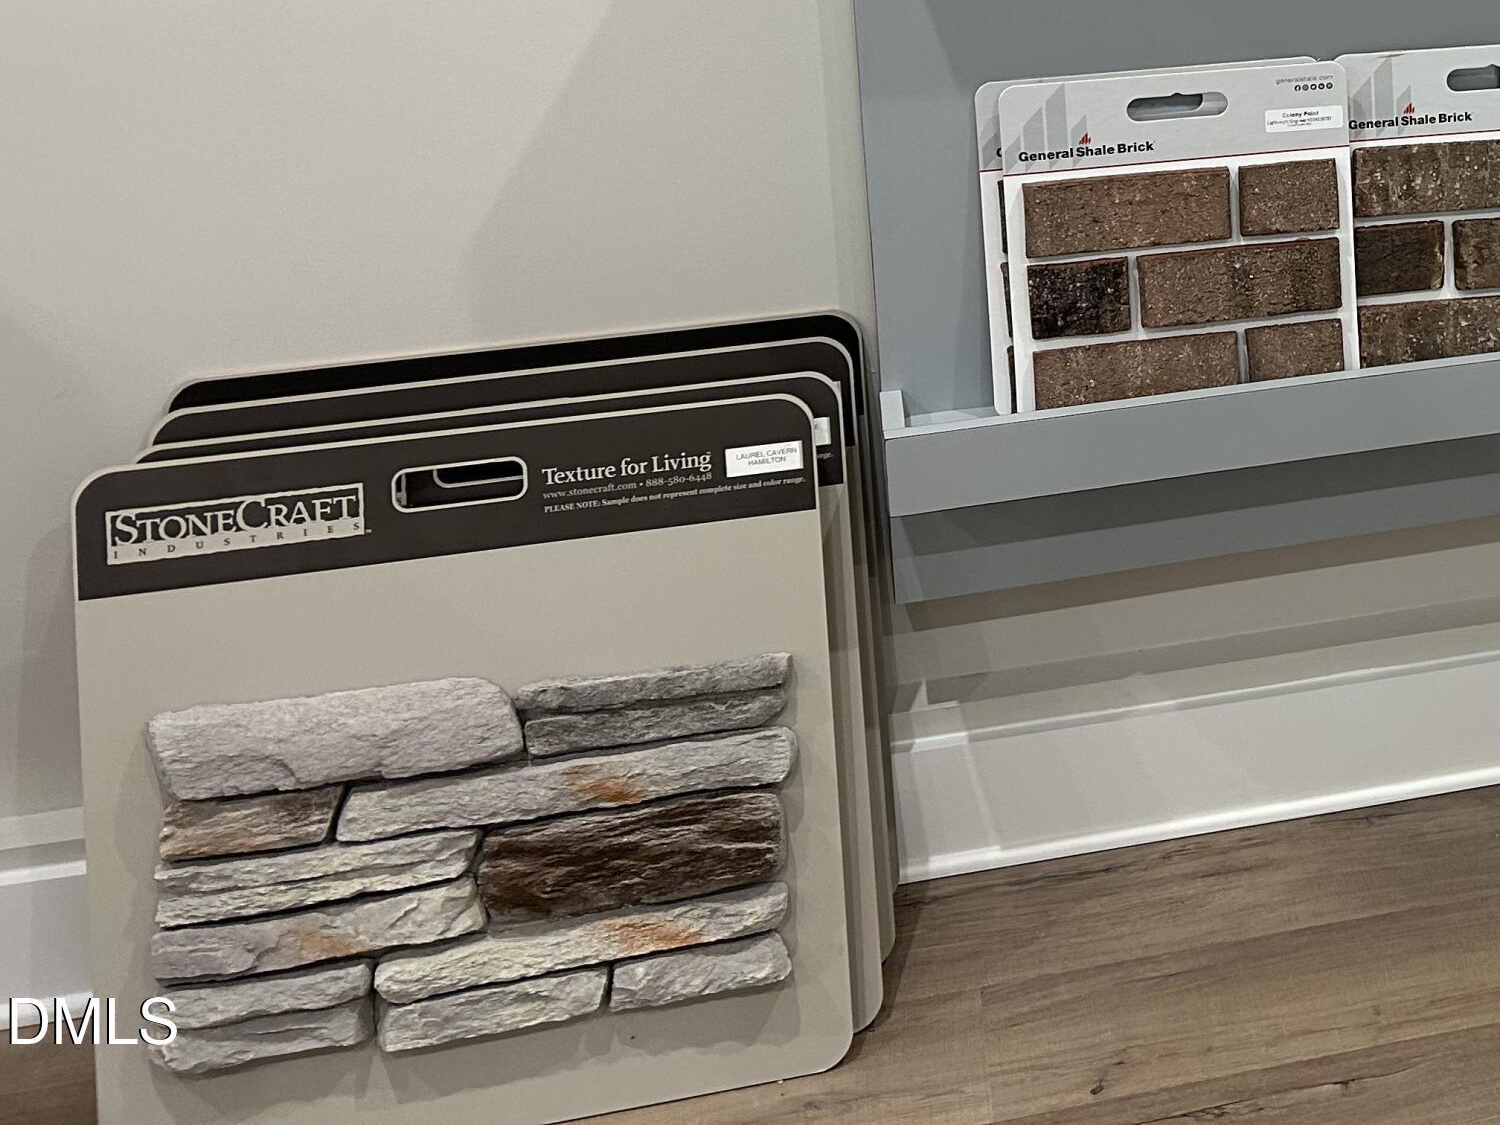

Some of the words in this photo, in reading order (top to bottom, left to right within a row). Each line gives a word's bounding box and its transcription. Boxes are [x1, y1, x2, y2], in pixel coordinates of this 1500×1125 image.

[1348, 116, 1399, 130] General
[1400, 114, 1436, 126] Shale
[1438, 111, 1472, 123] Brick
[1018, 148, 1074, 162] General
[1076, 144, 1115, 157] Shale
[1117, 141, 1154, 154] Brick
[736, 452, 765, 461] LAUREL
[766, 447, 798, 457] CAVERN
[748, 456, 787, 466] HAMILTON
[541, 464, 617, 485] Texture
[620, 457, 648, 476] for
[651, 452, 712, 473] Living
[542, 482, 638, 500] www.stonecraft.com
[645, 472, 713, 488] 888-580-6448
[543, 501, 575, 513] PLEASE
[601, 497, 630, 507] Sample
[630, 494, 648, 503] does
[649, 493, 662, 501] not
[662, 489, 699, 500] represent
[699, 485, 732, 496] complete
[732, 482, 747, 490] size
[747, 480, 762, 488] and
[763, 478, 782, 487] color
[113, 522, 360, 560] INDUSTRIES
